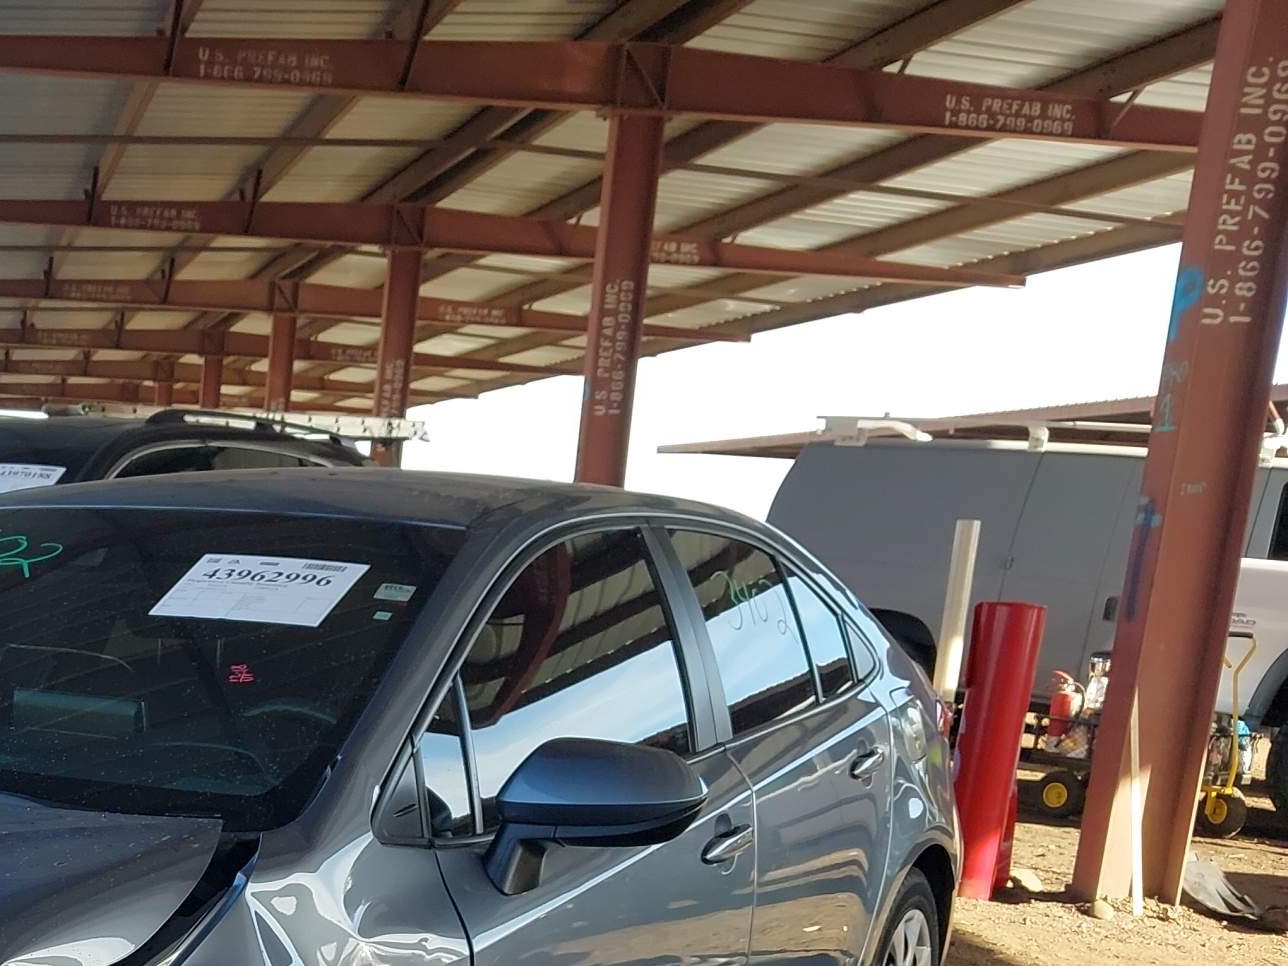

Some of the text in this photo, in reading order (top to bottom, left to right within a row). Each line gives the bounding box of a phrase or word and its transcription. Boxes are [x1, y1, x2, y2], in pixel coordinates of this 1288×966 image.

[945, 94, 1076, 120] U.S. PREFAB INC.
[944, 111, 1073, 135] 1-866-799-0969
[1201, 55, 1274, 325] U.S. PREFAB INC.
[597, 316, 616, 378] PREFAB
[201, 567, 333, 588] 43962996
